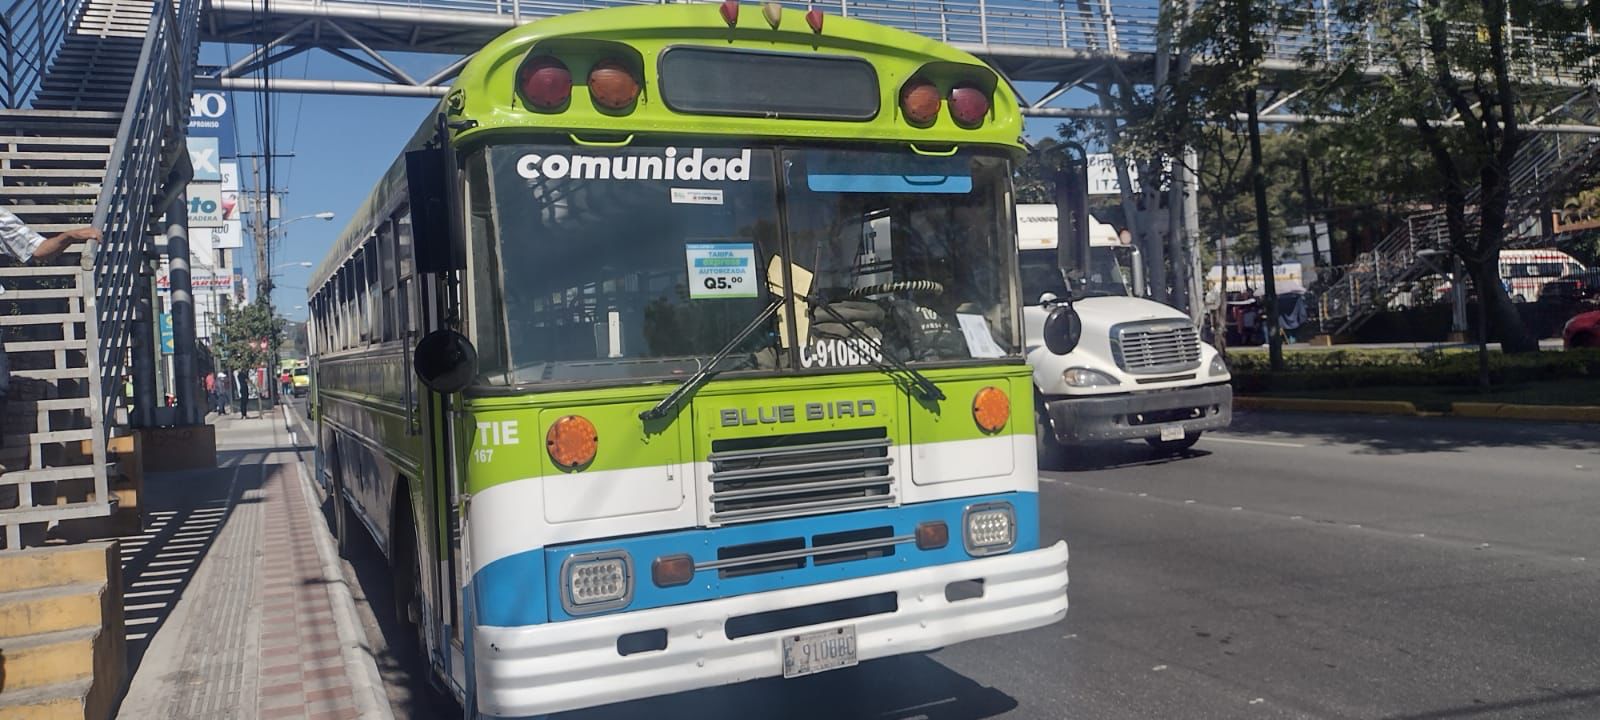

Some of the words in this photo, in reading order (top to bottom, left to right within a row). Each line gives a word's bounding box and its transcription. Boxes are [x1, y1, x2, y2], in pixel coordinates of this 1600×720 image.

[516, 146, 751, 181] comunidad
[187, 196, 217, 214] to
[720, 404, 796, 427] BLUE
[806, 399, 877, 421] BIRD
[476, 420, 520, 446] TIE
[474, 449, 494, 464] 167
